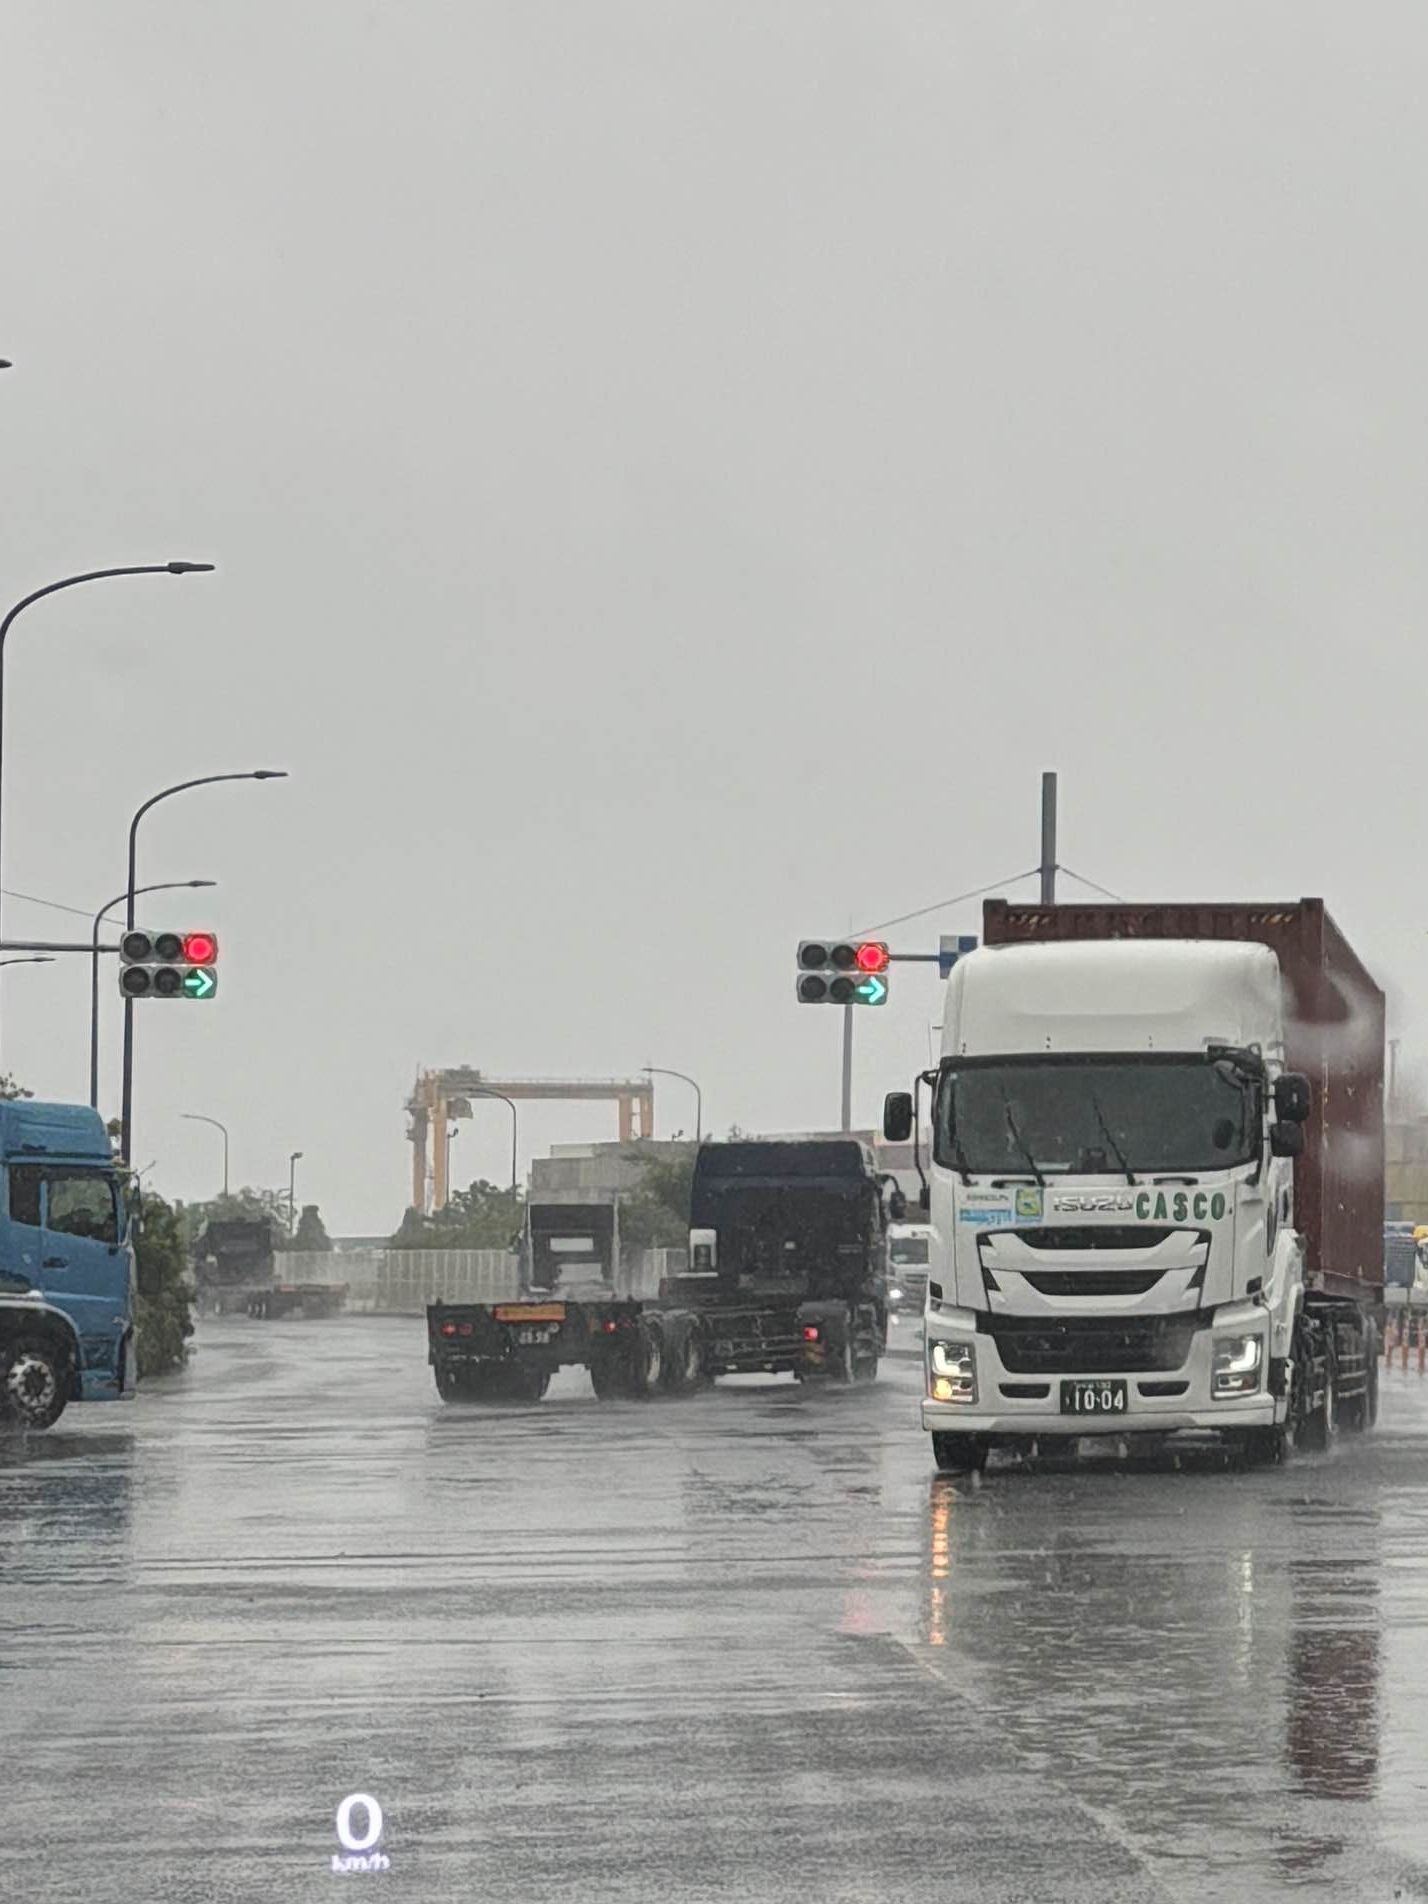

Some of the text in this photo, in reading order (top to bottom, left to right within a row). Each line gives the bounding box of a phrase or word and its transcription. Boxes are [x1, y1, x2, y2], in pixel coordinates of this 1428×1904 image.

[1135, 1192, 1226, 1222] CASCO
[1075, 1389, 1124, 1410] 10-04
[336, 1793, 383, 1850] 0
